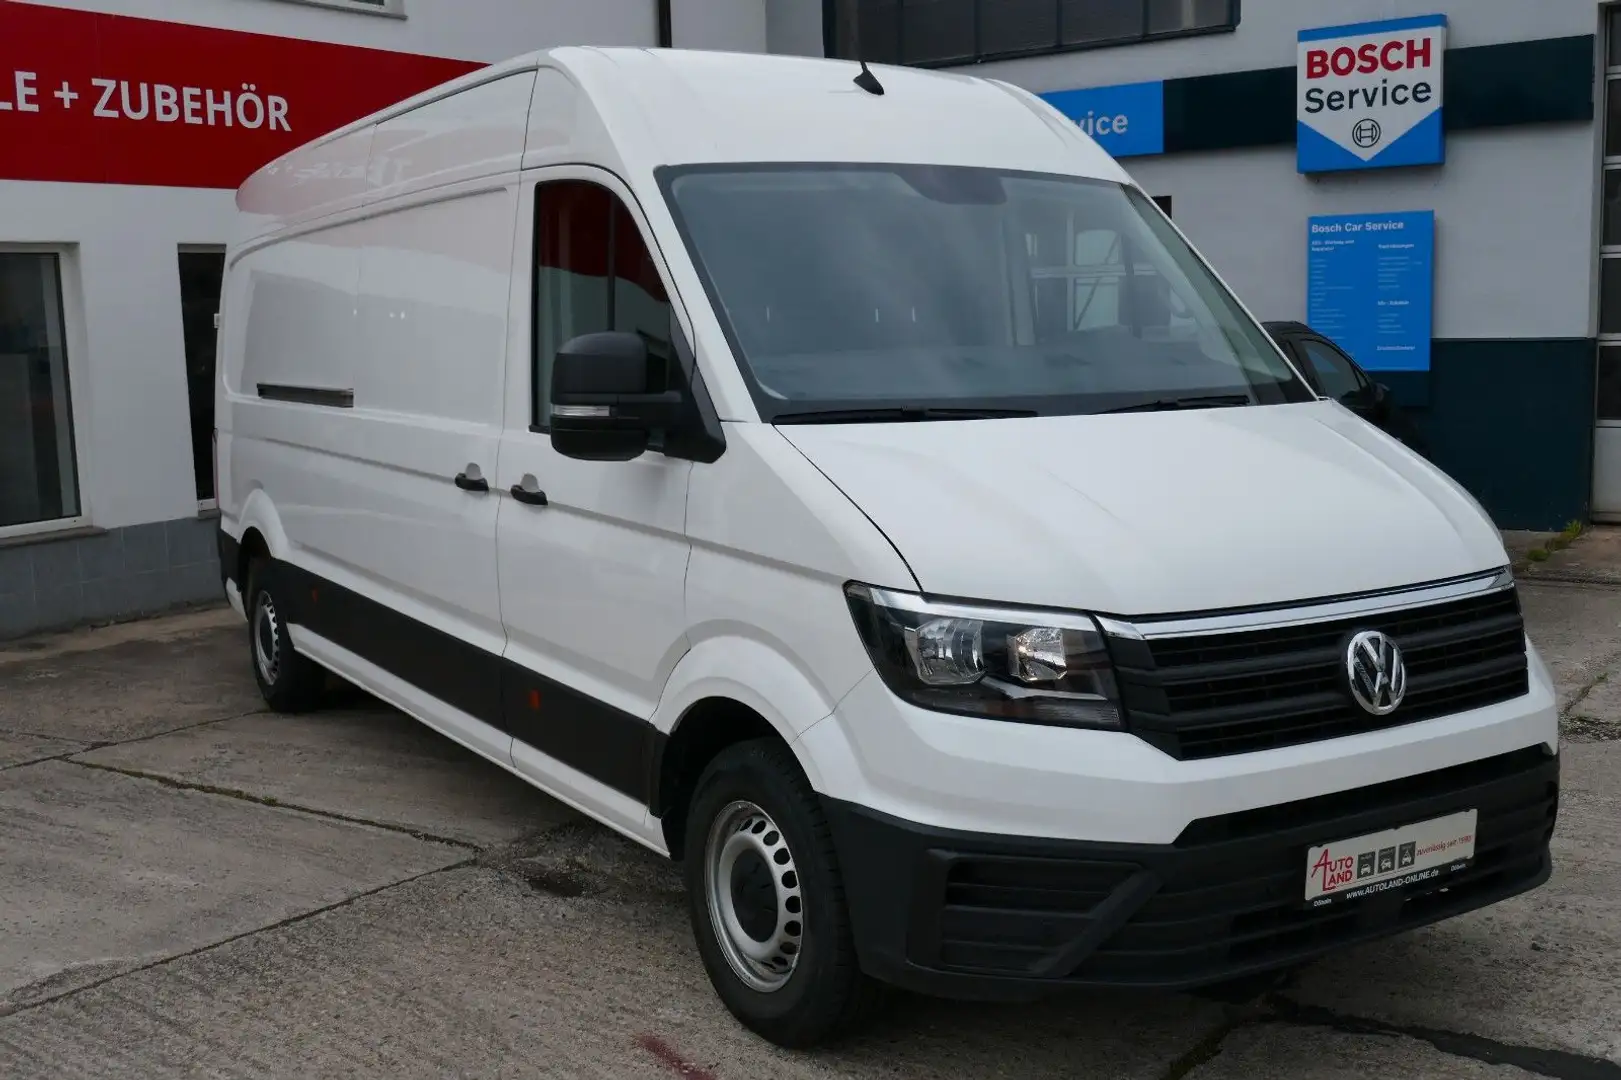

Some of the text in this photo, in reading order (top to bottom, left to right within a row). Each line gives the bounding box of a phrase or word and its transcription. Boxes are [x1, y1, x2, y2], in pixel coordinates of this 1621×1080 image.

[1306, 37, 1431, 79] BOSCH
[91, 78, 292, 131] ZUBEHÖR
[1304, 78, 1432, 114] Service
[1311, 220, 1404, 233] Bosch Car Service
[1311, 848, 1354, 878] AUTO
[1322, 868, 1353, 891] LAND
[1346, 870, 1440, 899] www.AUTOLAND-ONLINE.de
